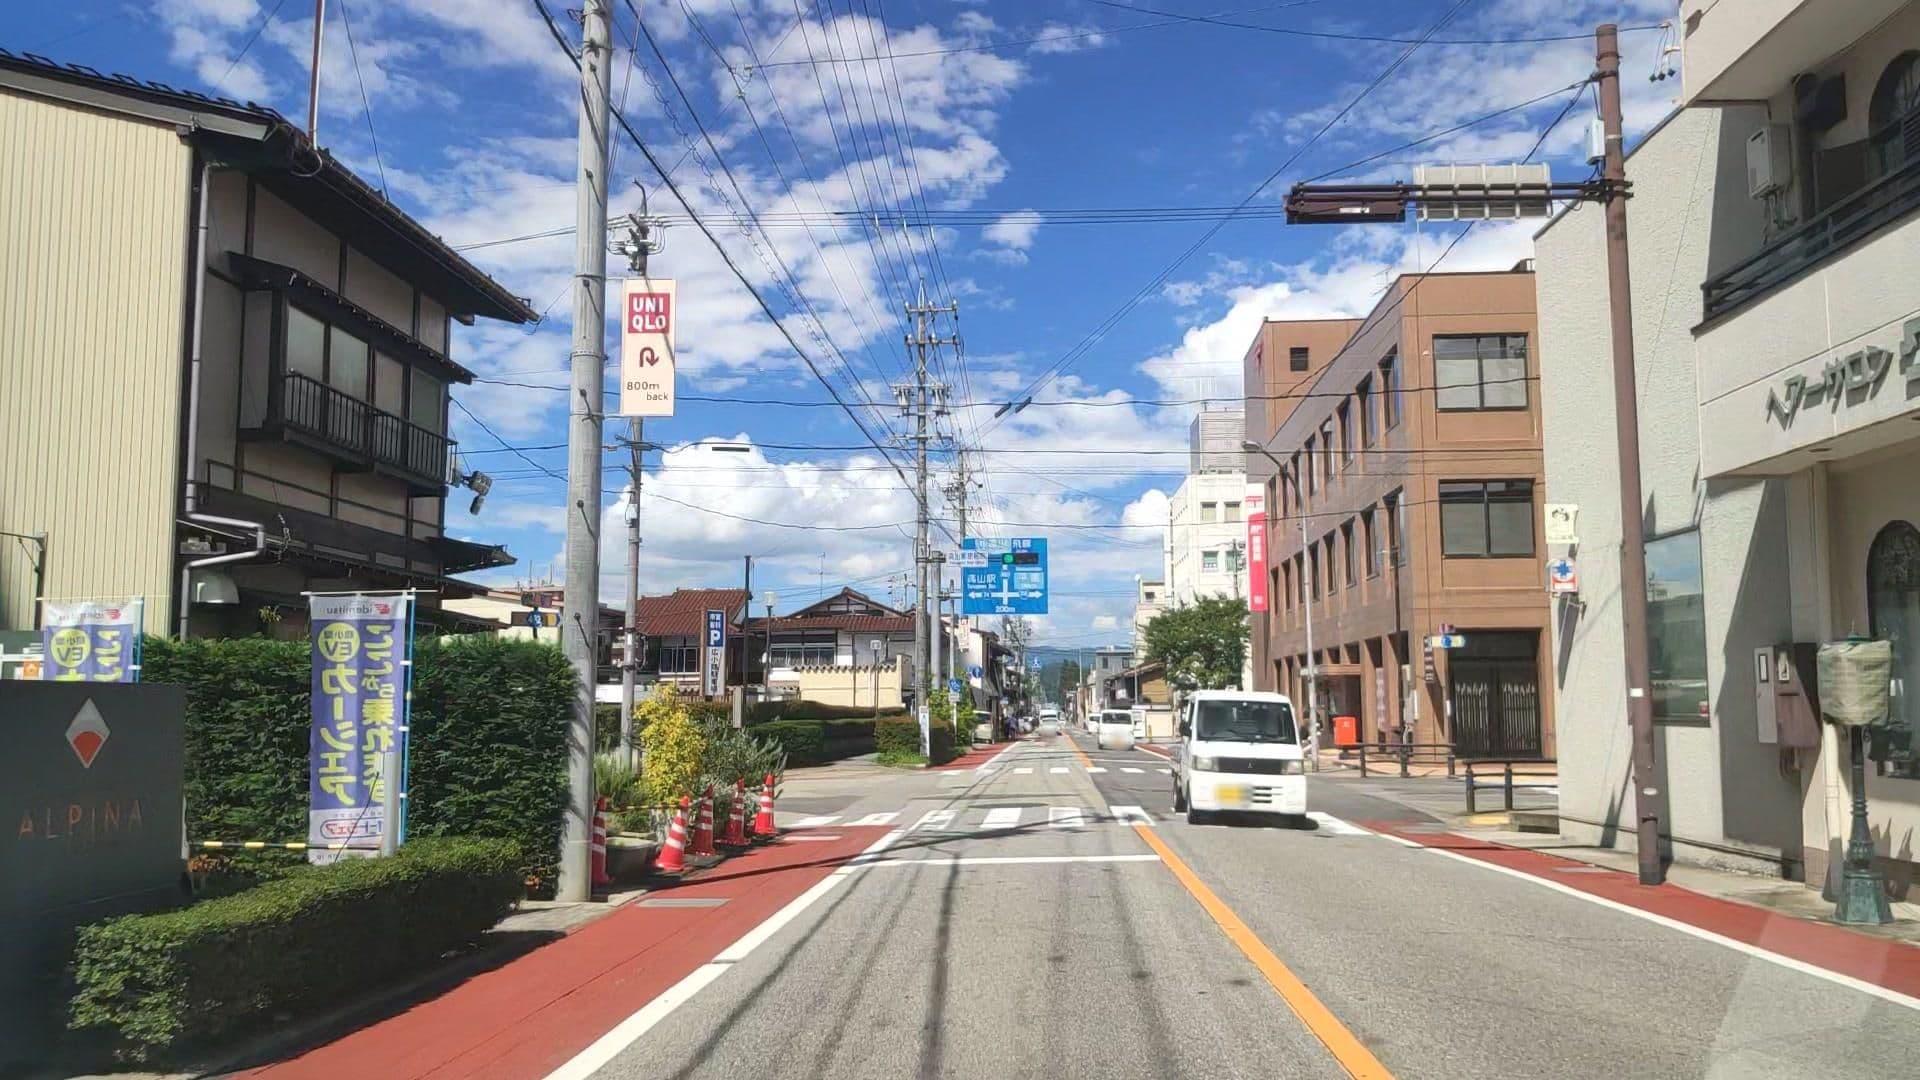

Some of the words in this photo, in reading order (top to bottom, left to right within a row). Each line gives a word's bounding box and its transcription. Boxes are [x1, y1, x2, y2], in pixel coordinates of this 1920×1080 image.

[632, 296, 664, 313] UNI
[632, 314, 666, 332] QLO
[626, 381, 660, 391] 800m
[1766, 345, 1892, 424] ヘアーサロン
[646, 391, 669, 401] back
[995, 605, 1016, 613] 200m
[709, 630, 721, 646] P
[16, 799, 143, 841] ALPINA
